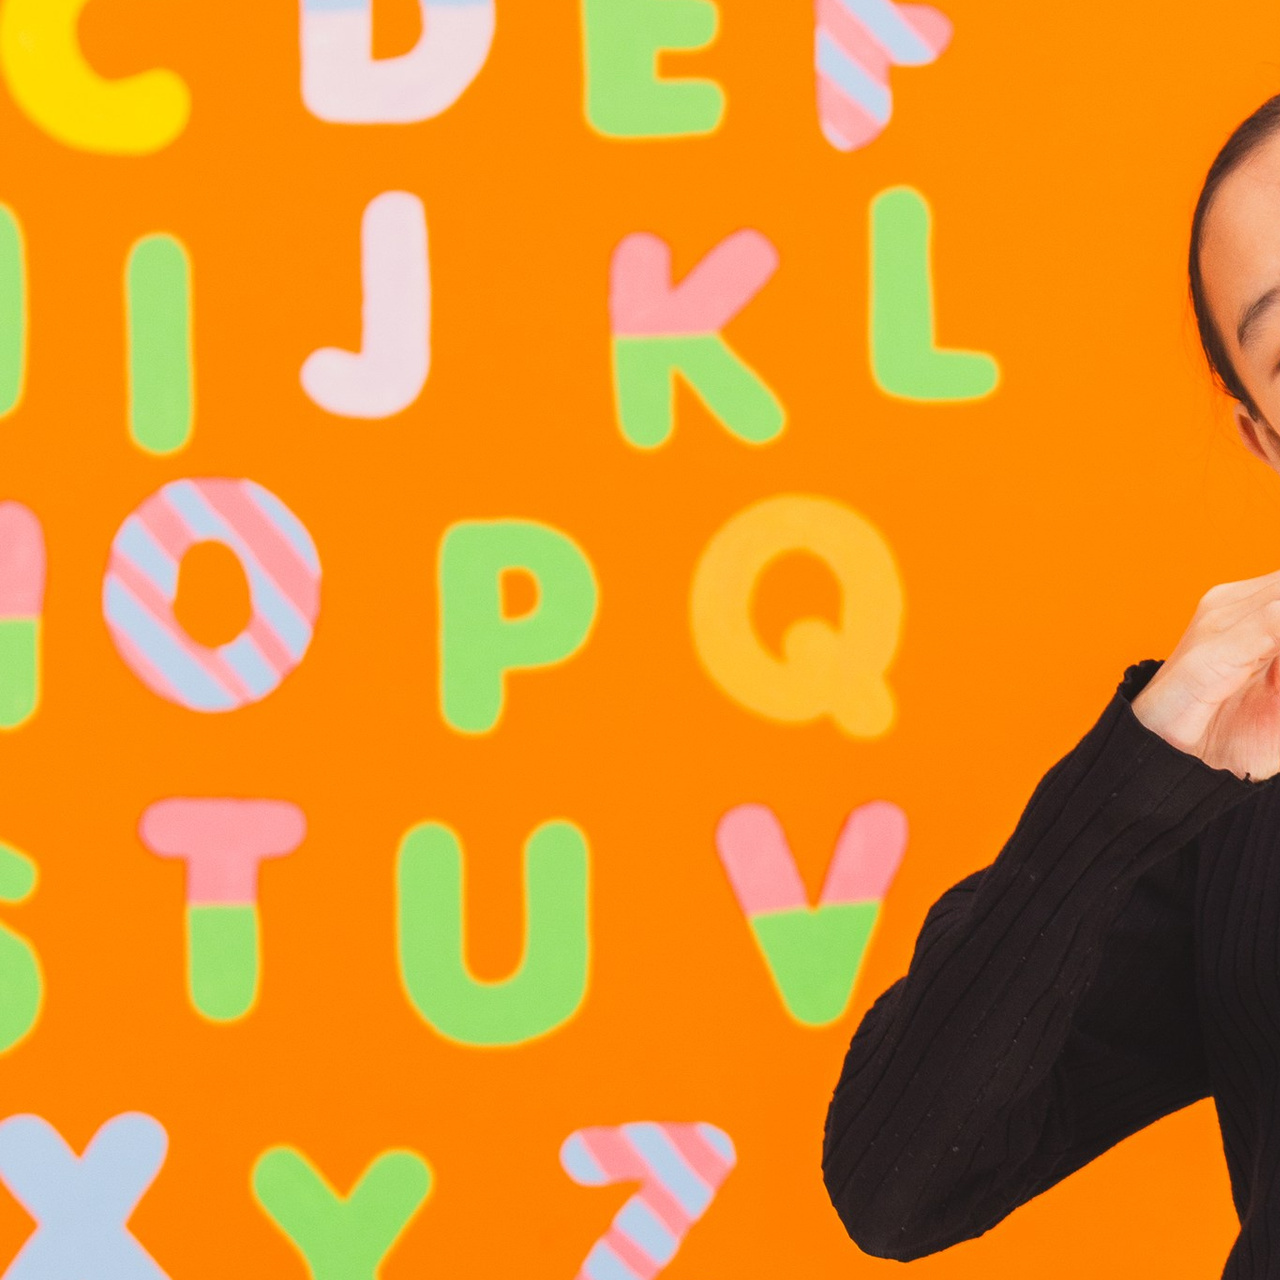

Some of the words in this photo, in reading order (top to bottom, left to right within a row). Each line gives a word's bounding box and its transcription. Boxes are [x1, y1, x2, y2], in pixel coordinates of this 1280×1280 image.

[299, 190, 432, 420] J
[609, 227, 787, 450] K
[868, 185, 1000, 402] L
[101, 477, 323, 714] O
[437, 518, 599, 735] P
[689, 494, 905, 738] Q
[139, 798, 306, 1023] T
[395, 819, 591, 1048] U
[715, 800, 909, 1026] V
